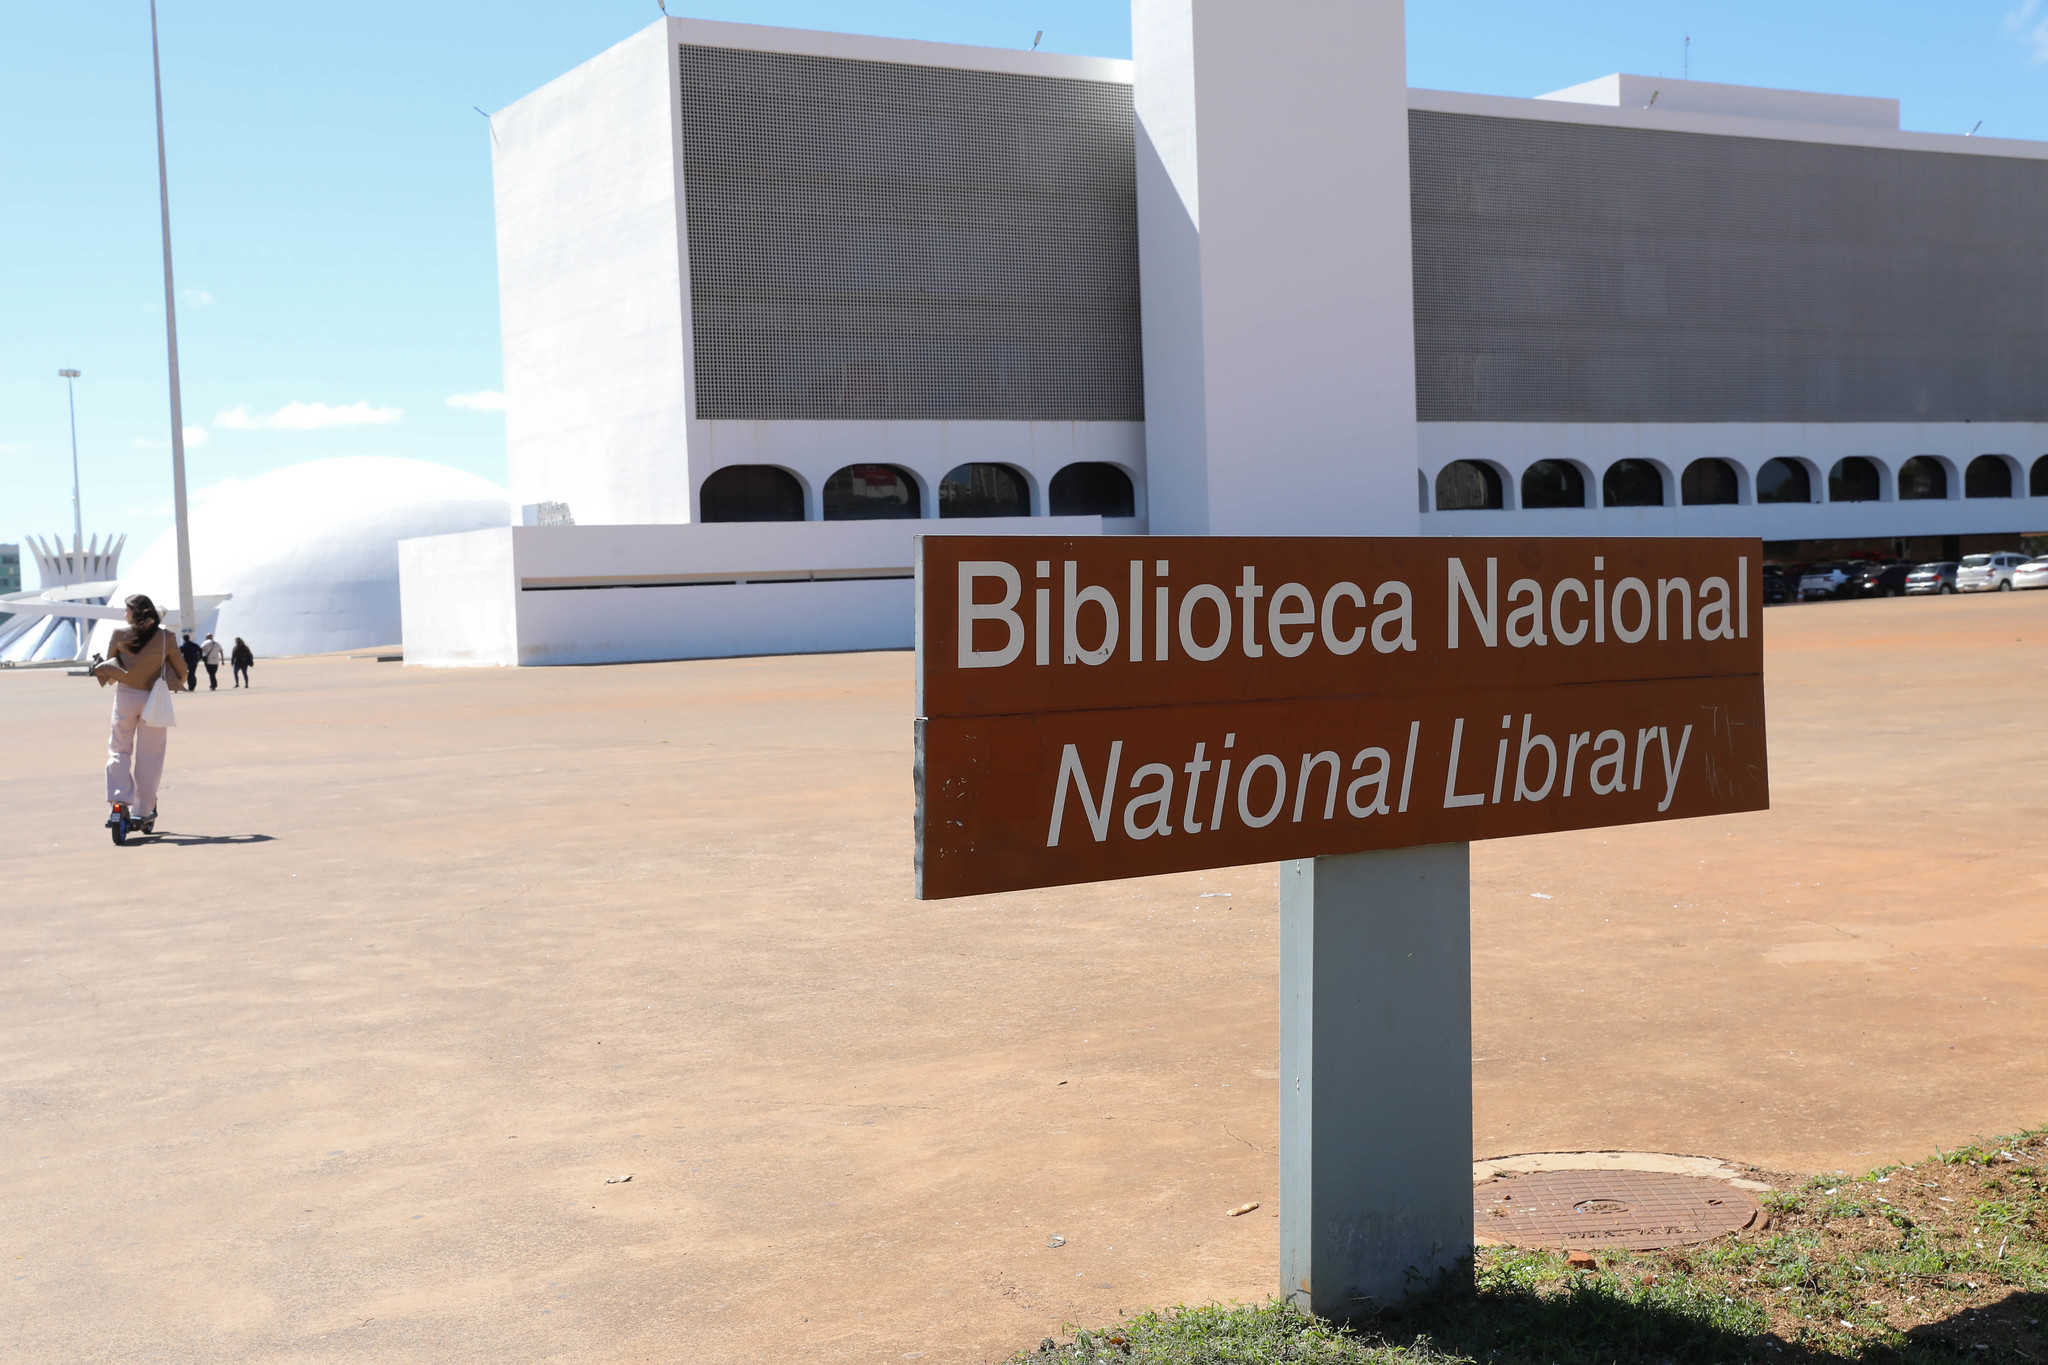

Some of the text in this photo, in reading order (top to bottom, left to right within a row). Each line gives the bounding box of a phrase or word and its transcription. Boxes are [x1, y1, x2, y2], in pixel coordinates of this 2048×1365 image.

[957, 556, 1748, 669] Biblioteca Nacional
[1046, 720, 1420, 848] National
[1443, 713, 1693, 812] Library
